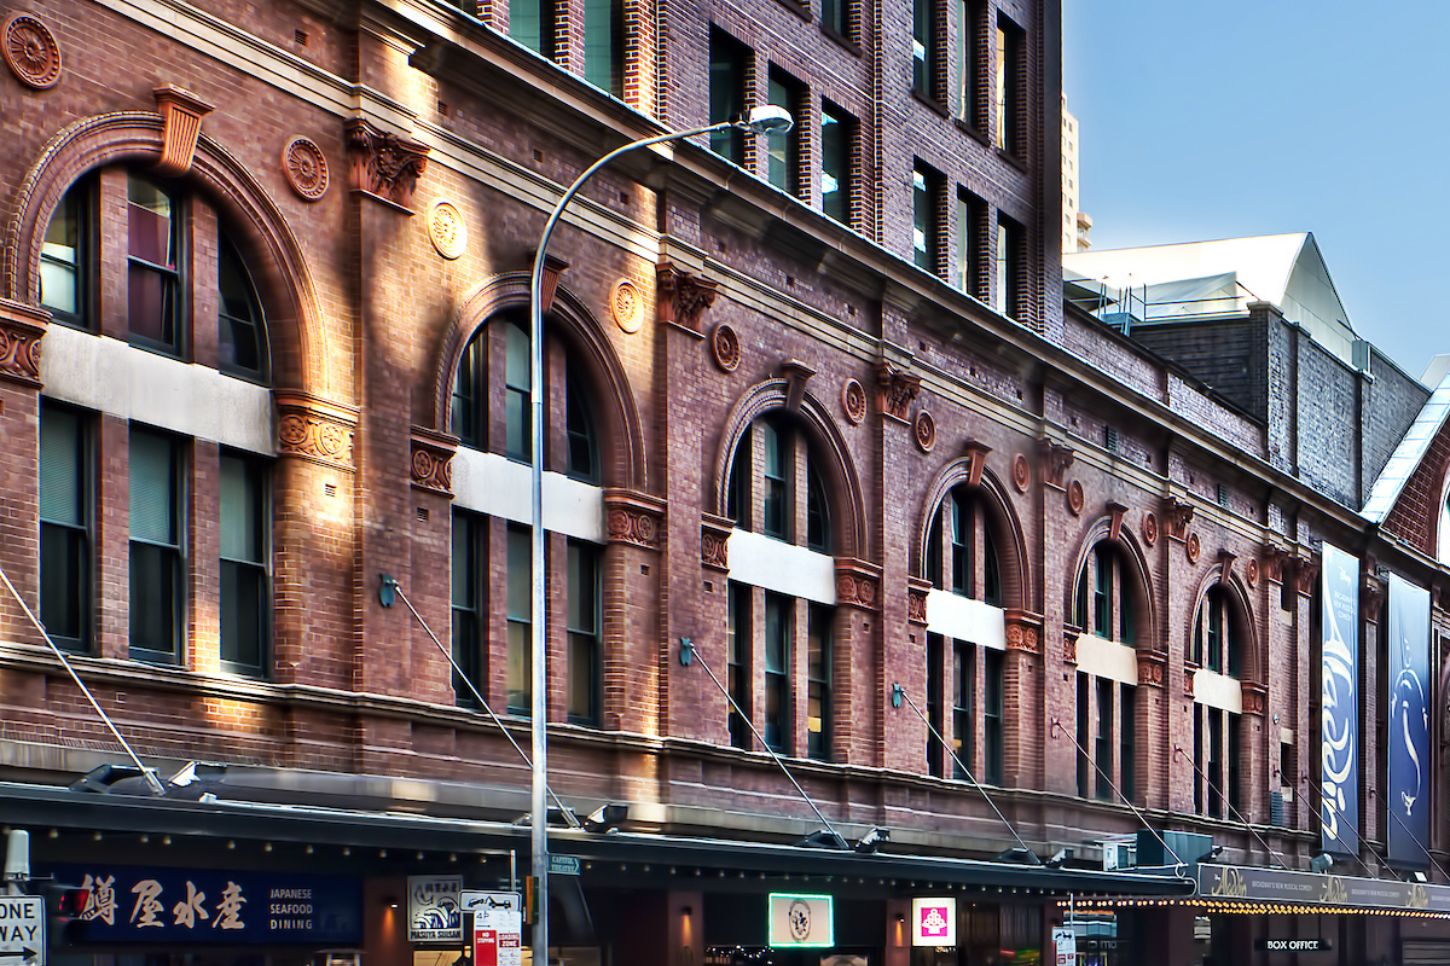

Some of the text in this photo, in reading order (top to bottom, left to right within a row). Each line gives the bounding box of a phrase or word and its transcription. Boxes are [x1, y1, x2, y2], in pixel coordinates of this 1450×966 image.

[269, 888, 313, 900] JAPANESE
[269, 903, 314, 915] SEAFOOD
[269, 919, 313, 930] DINING
[1267, 940, 1319, 950] BOX OFFICE
